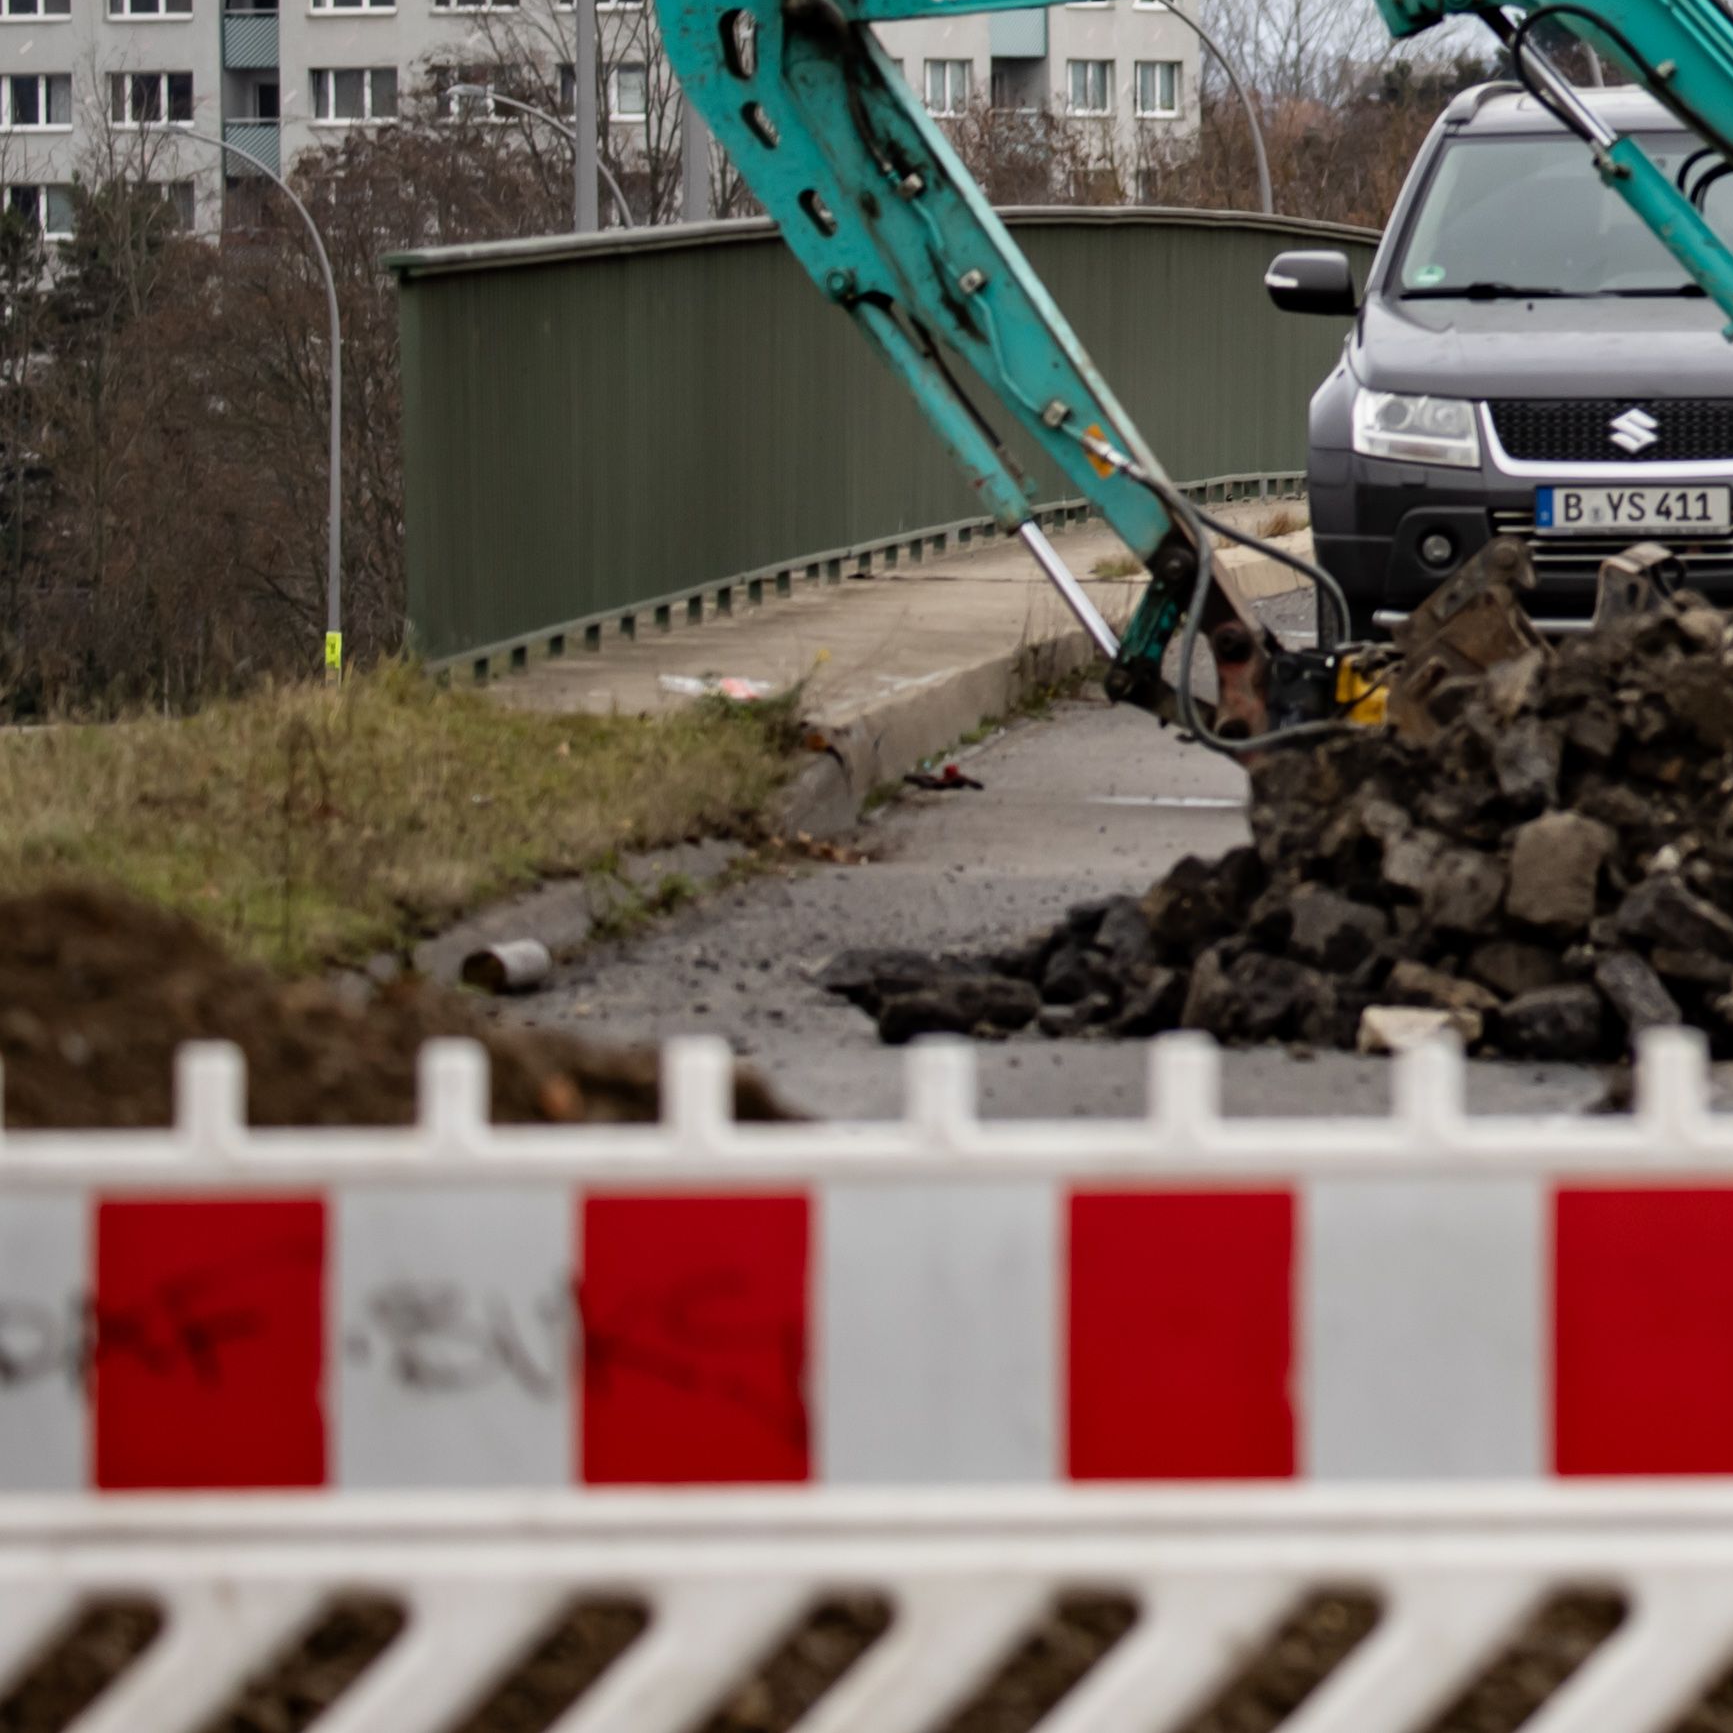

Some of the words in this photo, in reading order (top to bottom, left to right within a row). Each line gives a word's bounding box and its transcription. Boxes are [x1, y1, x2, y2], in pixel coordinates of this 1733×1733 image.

[1563, 492, 1584, 522] B
[1606, 491, 1646, 522] YS
[1654, 491, 1712, 522] 411
